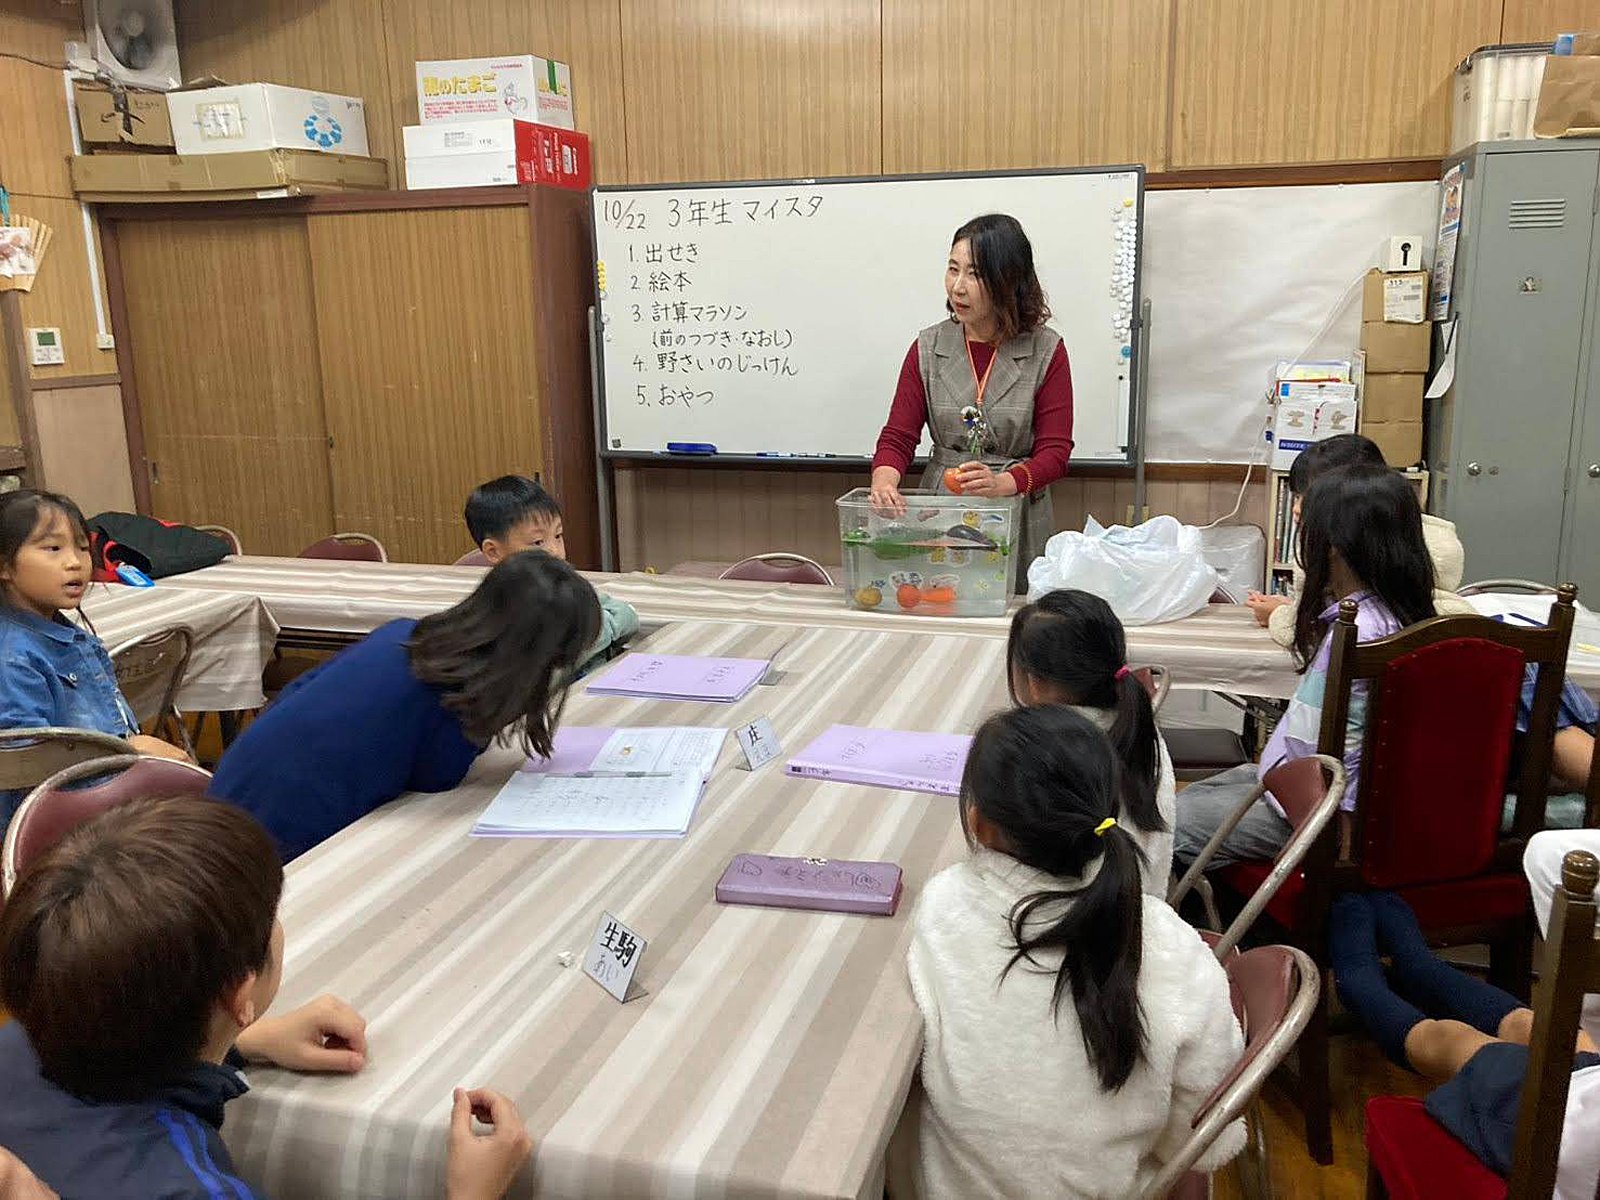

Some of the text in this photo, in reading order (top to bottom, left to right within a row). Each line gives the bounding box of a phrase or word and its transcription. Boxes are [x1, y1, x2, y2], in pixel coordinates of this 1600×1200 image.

[604, 199, 647, 229] 10/22
[743, 196, 823, 220] マイスタ
[645, 243, 698, 264] 出せき
[648, 270, 692, 293] 絵本
[651, 301, 747, 323] 計算マラソン
[657, 351, 798, 376] 野さいのじっけん
[659, 383, 714, 408] おやつ
[600, 922, 637, 967] 生駒
